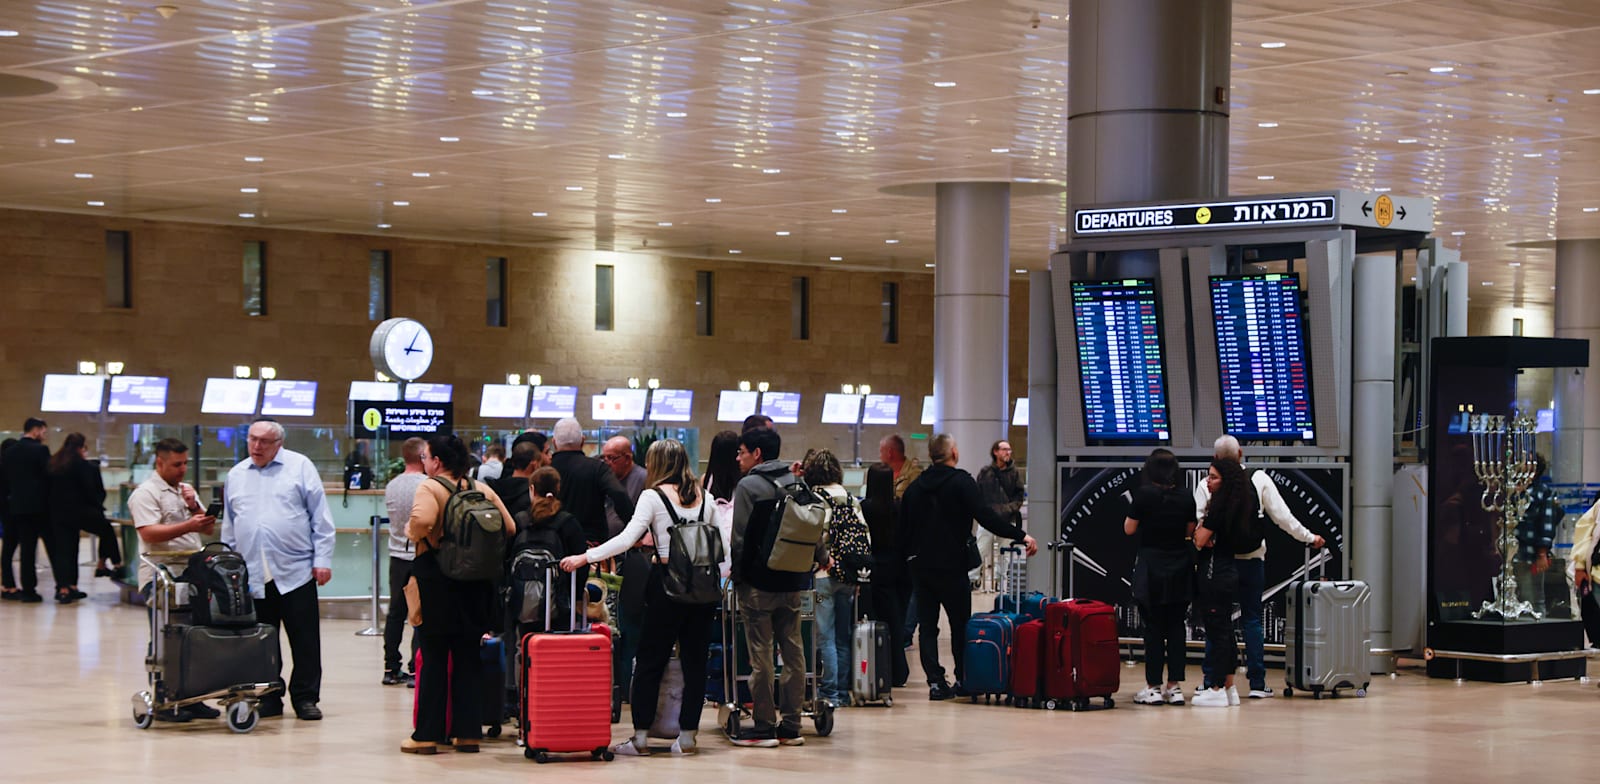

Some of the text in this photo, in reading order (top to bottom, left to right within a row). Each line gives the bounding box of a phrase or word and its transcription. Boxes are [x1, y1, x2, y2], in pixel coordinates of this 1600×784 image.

[1233, 202, 1327, 222] המראות
[1081, 210, 1174, 229] DEPARTURES
[390, 424, 437, 432] INFORMATION
[1111, 474, 1123, 488] 55
[1273, 473, 1287, 486] 05
